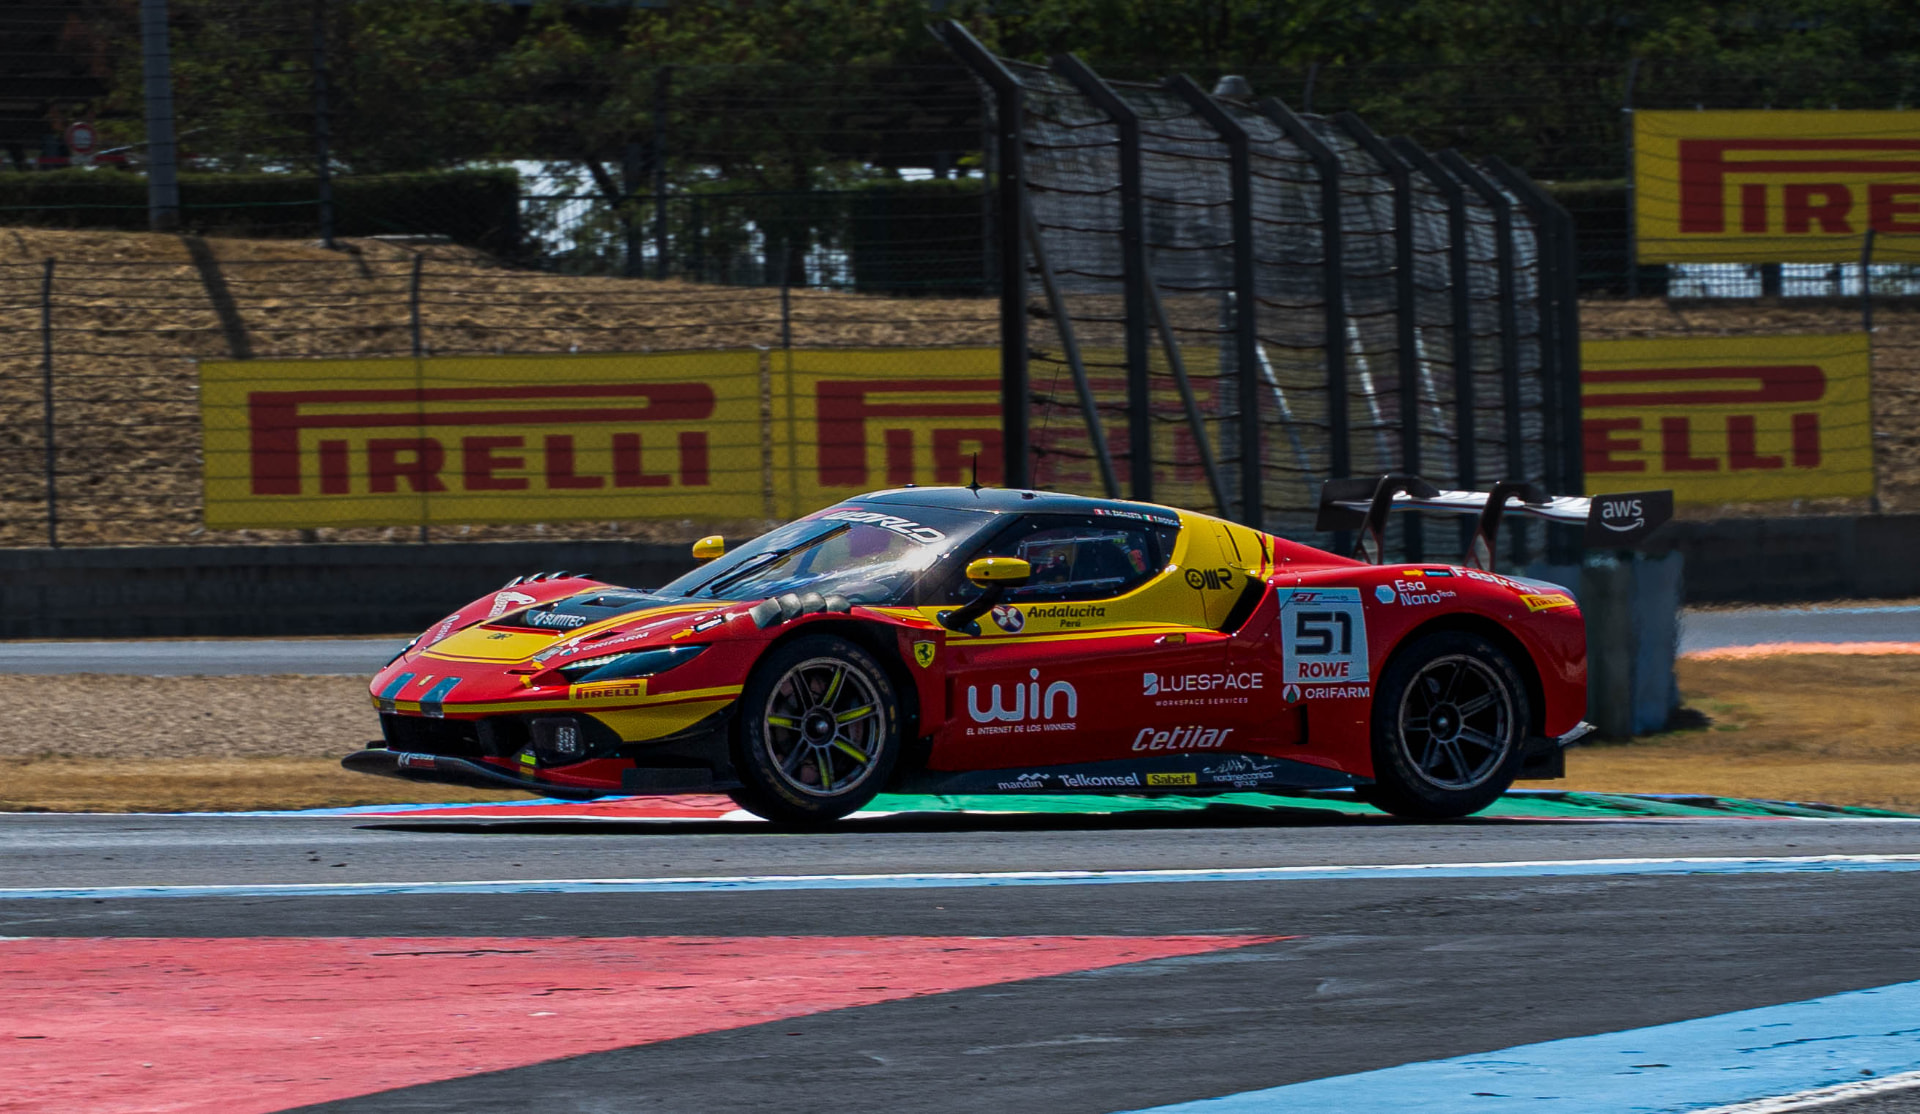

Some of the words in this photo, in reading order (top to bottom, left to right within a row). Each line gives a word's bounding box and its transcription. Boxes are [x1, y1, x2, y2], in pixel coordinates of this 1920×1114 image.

[1581, 365, 1826, 473] ELLI
[249, 382, 716, 495] PIRELLI
[815, 378, 1273, 488] PIRELL
[1602, 499, 1643, 518] aws
[821, 510, 946, 543] WORLD
[1394, 580, 1426, 592] Esa
[1027, 605, 1106, 618] Andalucita
[1059, 618, 1081, 628] Perú
[582, 632, 649, 651] ORIFARM
[1295, 611, 1352, 656] 51
[1298, 662, 1350, 678] ROWE
[576, 683, 639, 700] PIRELLI
[1143, 672, 1263, 696] BLUESPACE
[1305, 686, 1370, 699] ORIFARM
[967, 668, 1077, 723] win
[1155, 698, 1205, 707] WORKSPACE
[1208, 697, 1249, 705] SERVICES
[966, 728, 975, 736] EL
[977, 726, 1012, 735] INTERNET
[1014, 725, 1024, 733] DE
[1026, 724, 1041, 733] LOS
[1043, 723, 1076, 732] WINNERS
[1132, 725, 1234, 751] Cetilar
[1058, 773, 1140, 787] Telkomsel
